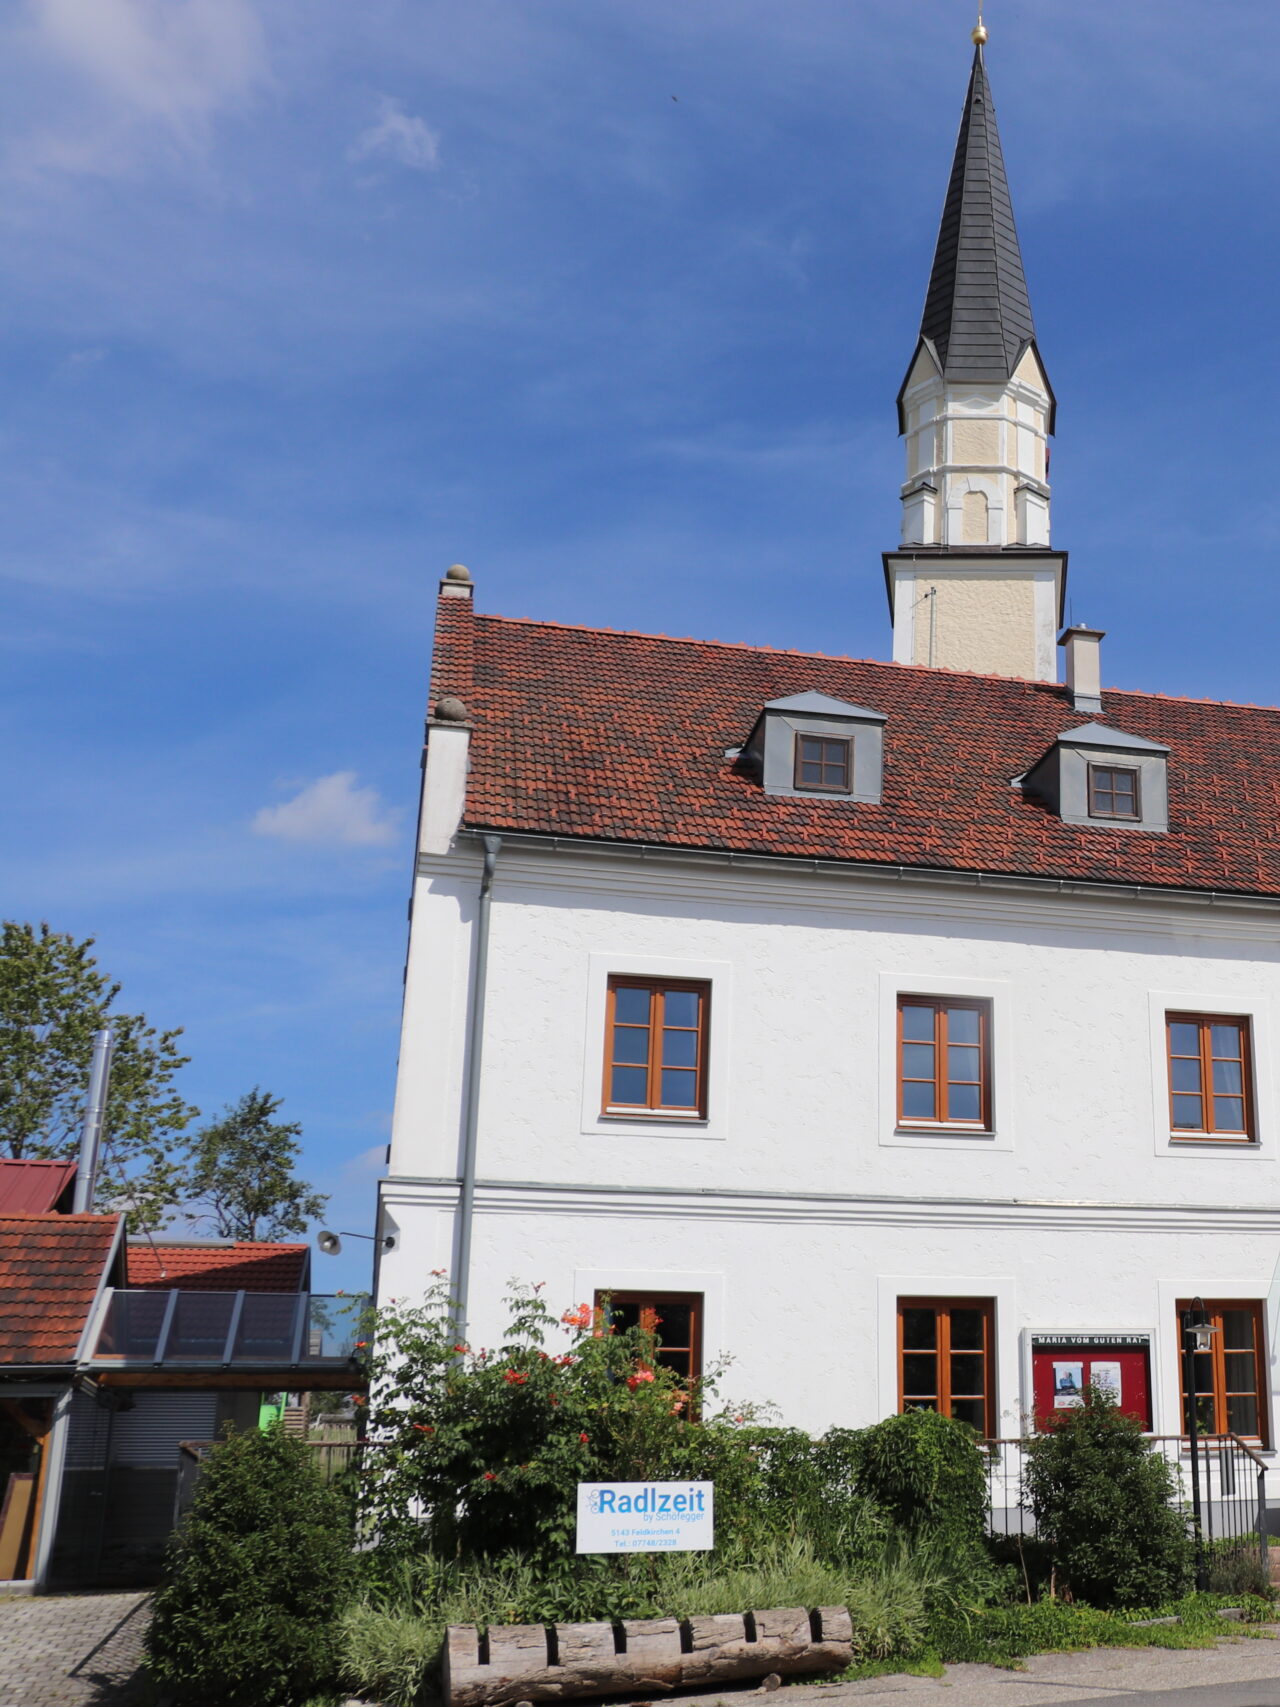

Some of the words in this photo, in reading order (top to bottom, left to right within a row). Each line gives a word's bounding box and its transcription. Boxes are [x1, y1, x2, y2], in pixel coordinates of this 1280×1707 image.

[600, 1488, 705, 1513] Radlzeit
[643, 1512, 654, 1523] by
[611, 1528, 630, 1537] 5143
[632, 1528, 674, 1536] Feldkirchen
[676, 1527, 681, 1535] 4
